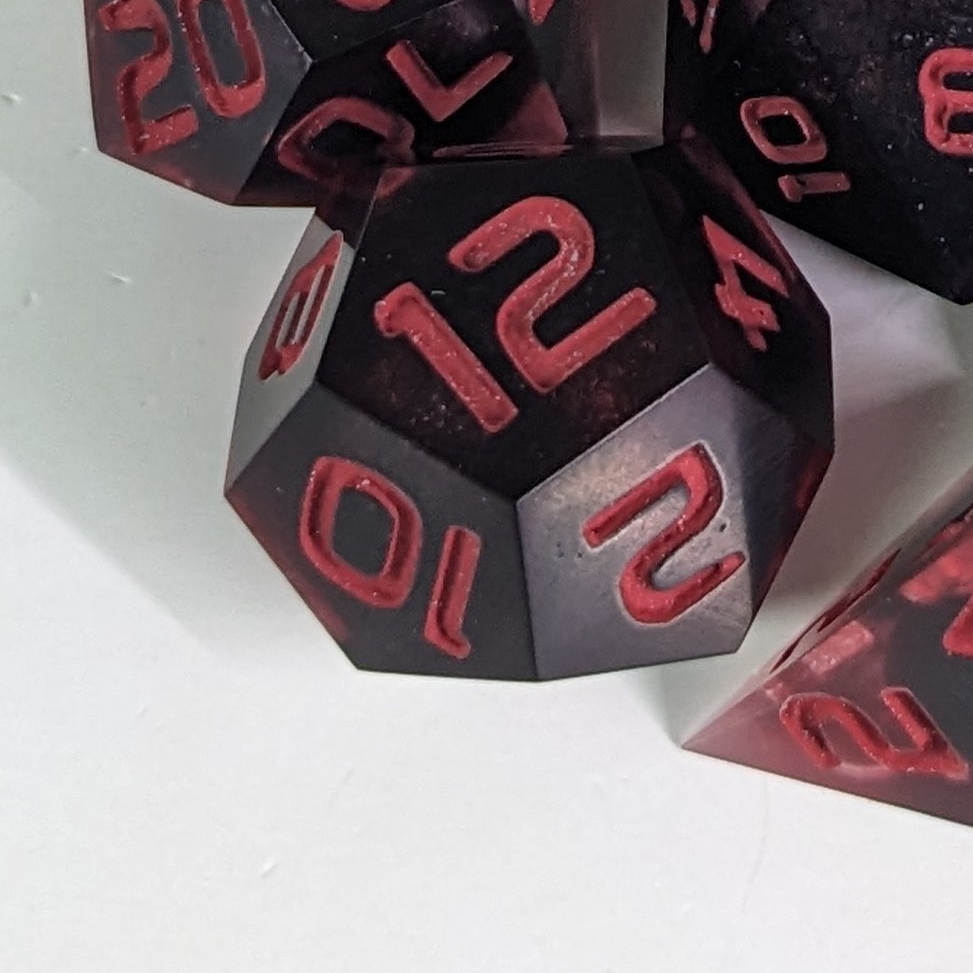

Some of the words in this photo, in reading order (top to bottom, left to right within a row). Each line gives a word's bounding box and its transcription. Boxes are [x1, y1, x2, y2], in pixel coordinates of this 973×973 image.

[740, 95, 851, 203] 10
[374, 195, 657, 433] 12
[702, 214, 789, 351] 4
[301, 455, 482, 660] 10
[582, 440, 745, 625] 2
